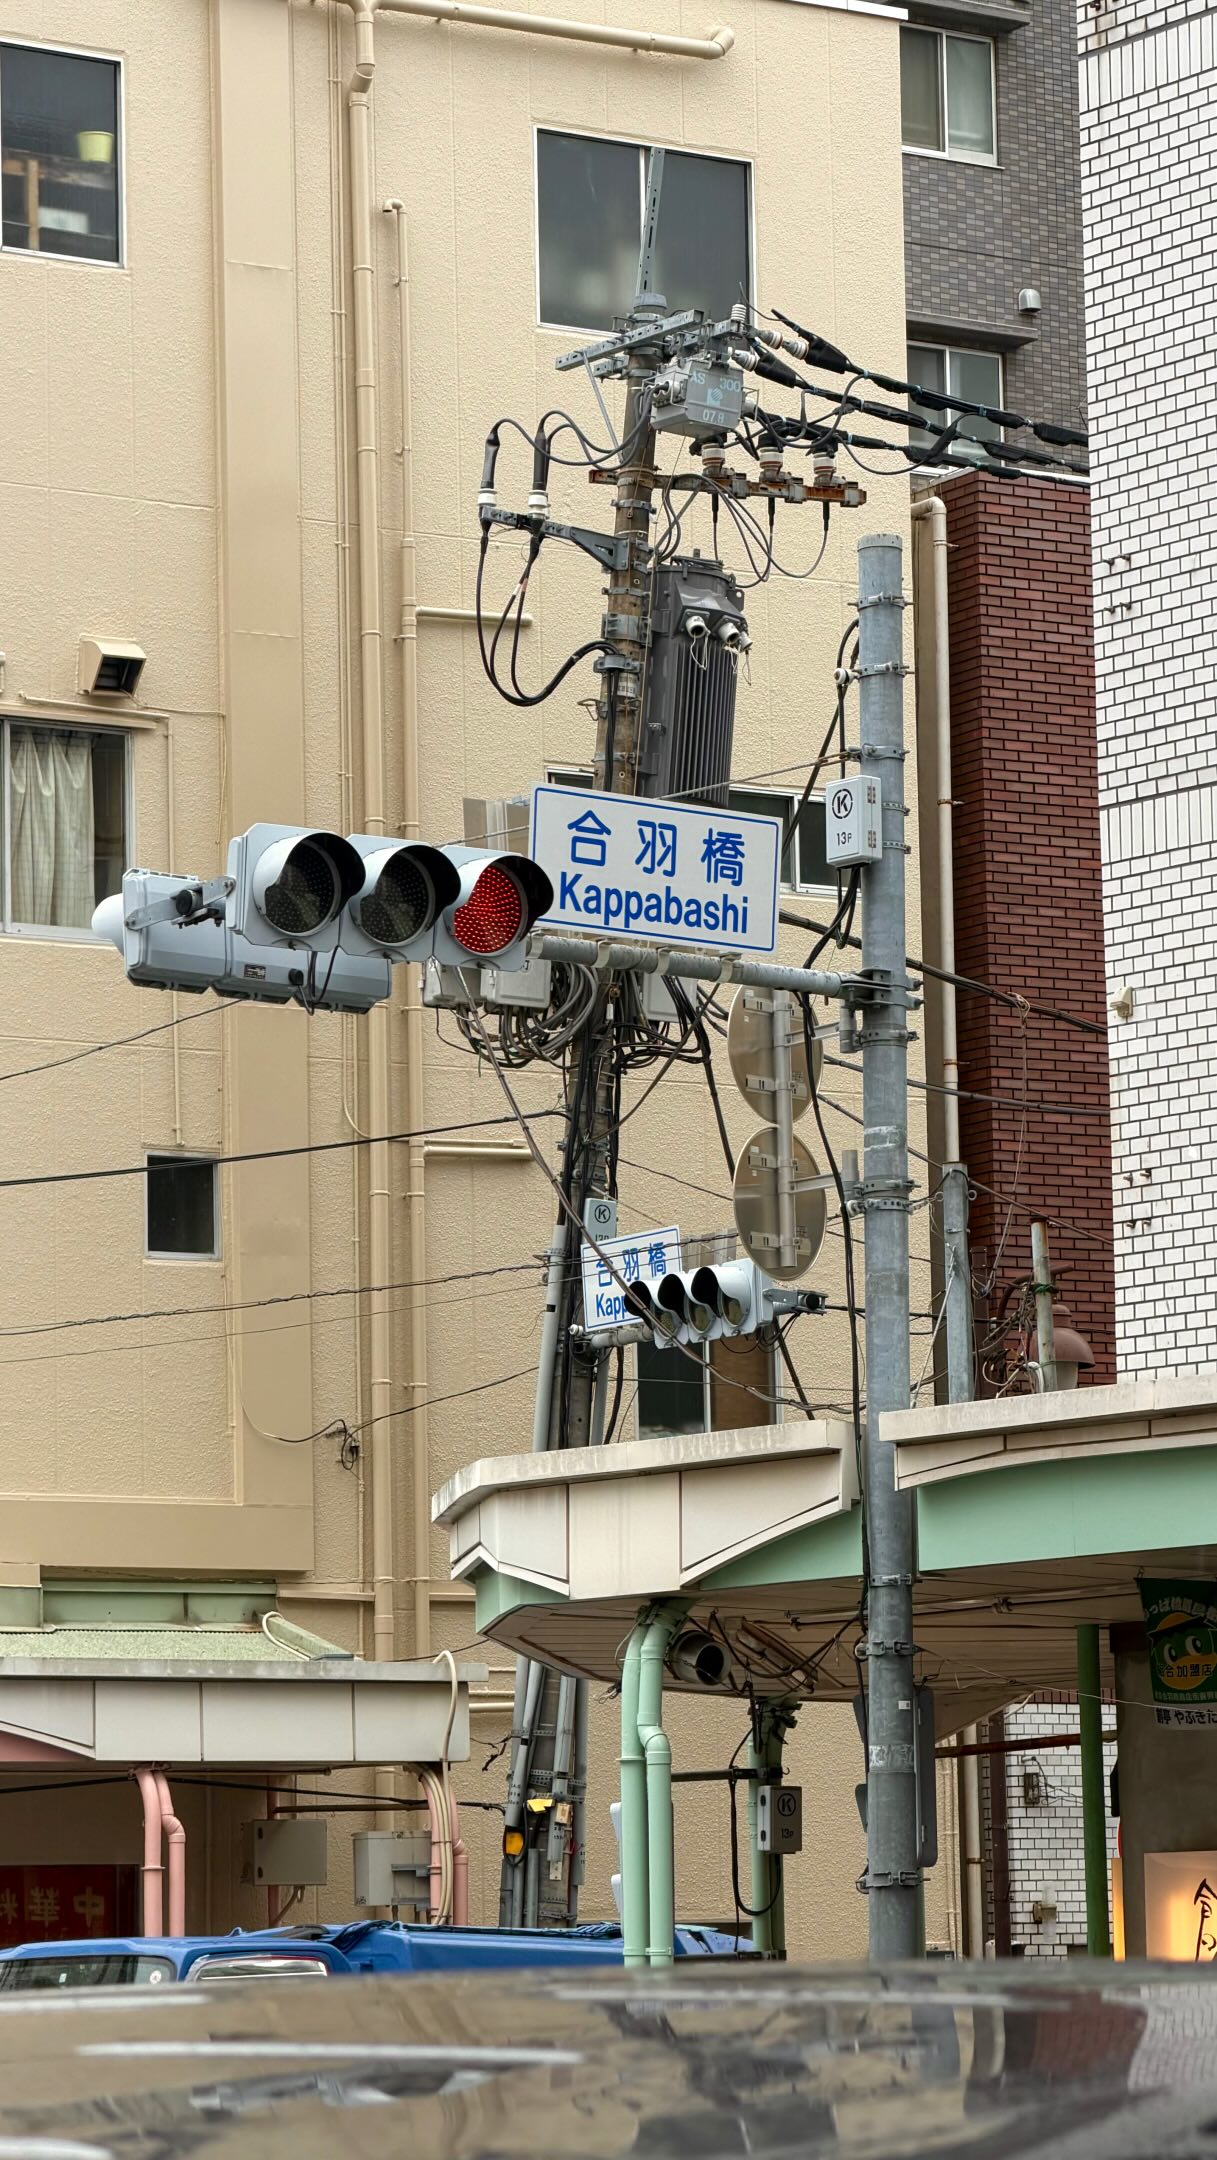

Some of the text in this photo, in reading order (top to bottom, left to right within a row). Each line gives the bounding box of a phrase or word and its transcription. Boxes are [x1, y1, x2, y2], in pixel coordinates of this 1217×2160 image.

[690, 371, 741, 392] AS 300
[568, 810, 745, 887] 合羽橋
[560, 871, 749, 934] Kappabashi
[596, 1242, 667, 1287] 合羽橋
